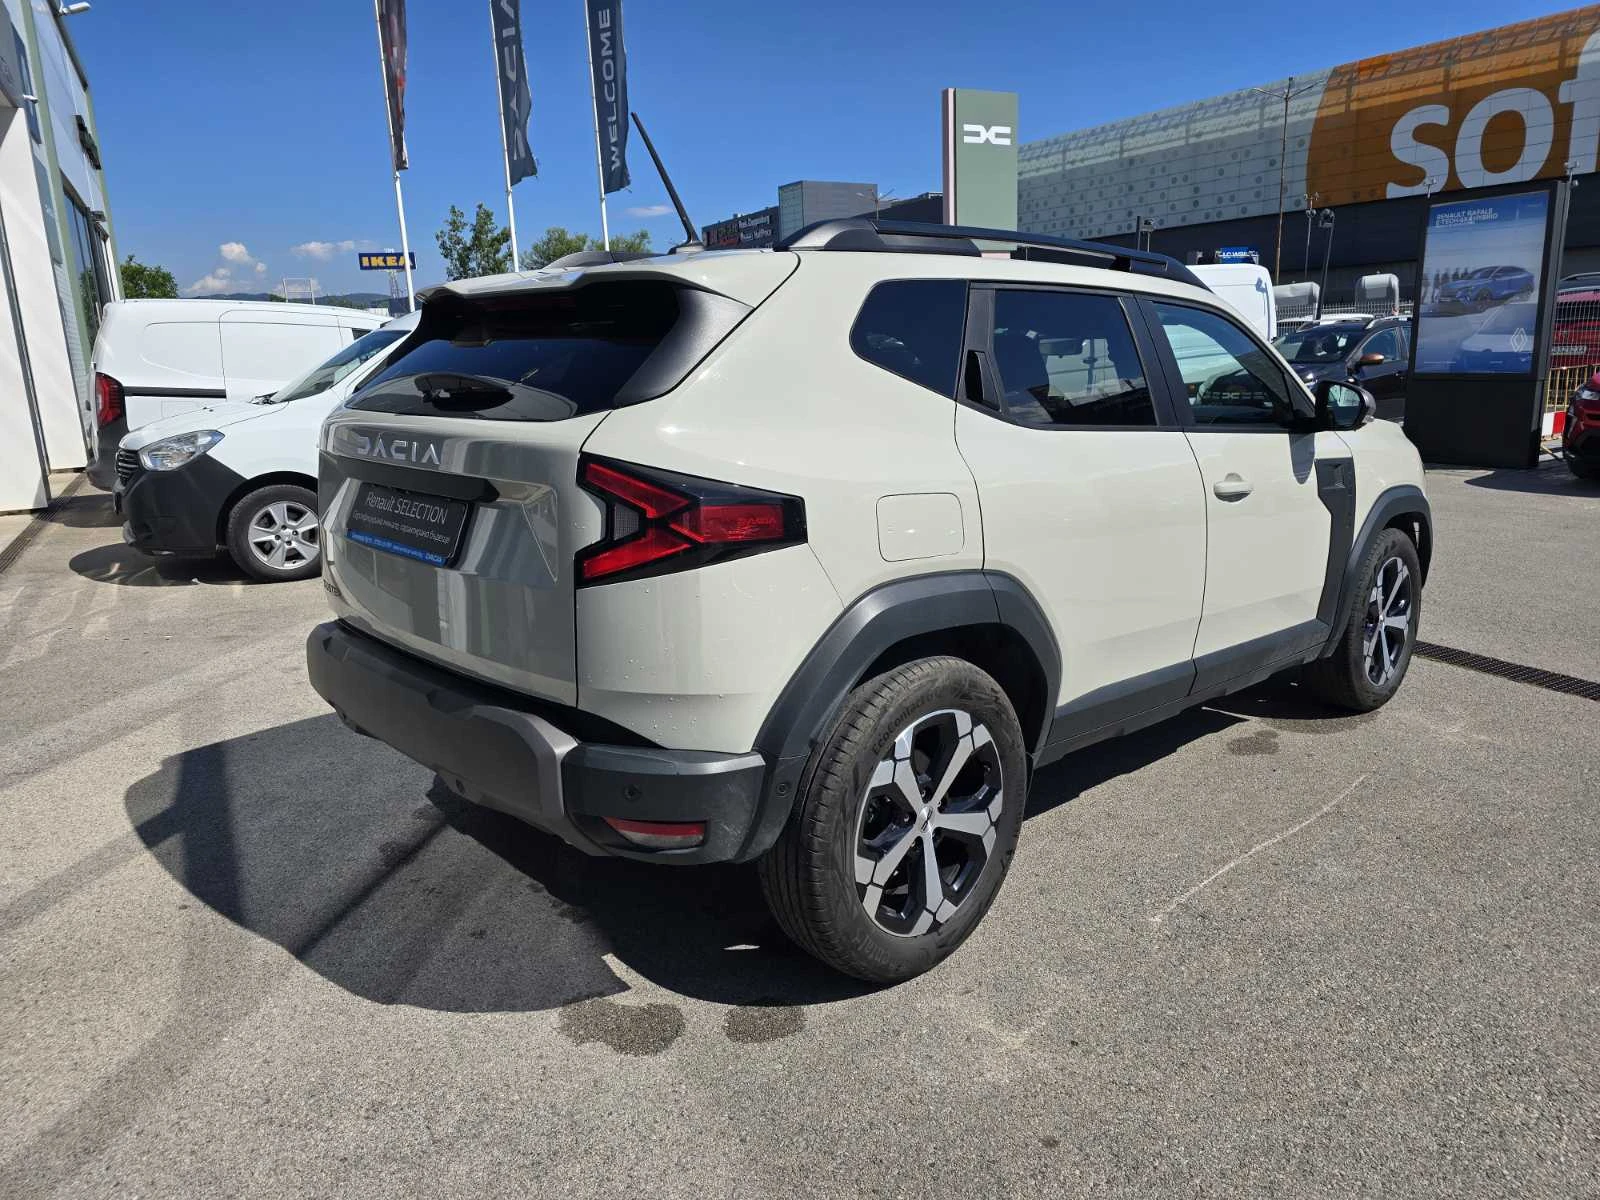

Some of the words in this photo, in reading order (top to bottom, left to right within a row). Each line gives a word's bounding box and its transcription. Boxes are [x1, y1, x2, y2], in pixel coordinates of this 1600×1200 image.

[598, 8, 621, 171] WELCOME
[357, 437, 440, 465] DACIA
[366, 491, 396, 512] Renault
[394, 497, 448, 525] SELECTION
